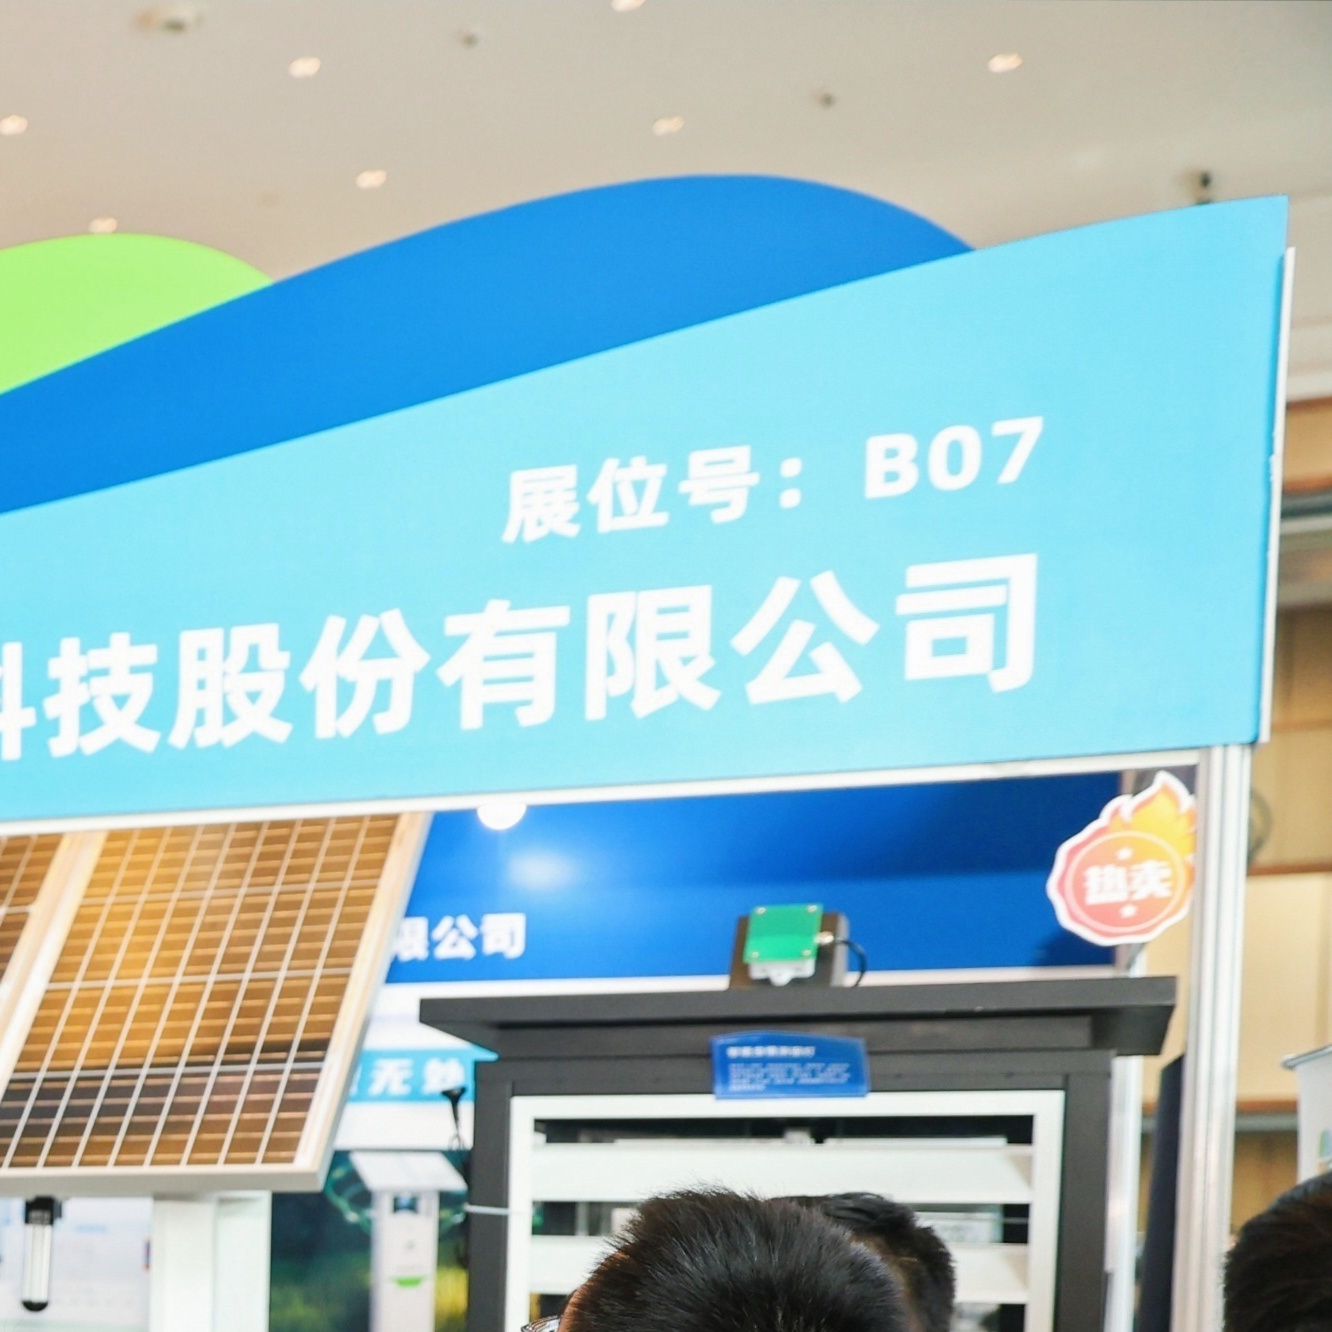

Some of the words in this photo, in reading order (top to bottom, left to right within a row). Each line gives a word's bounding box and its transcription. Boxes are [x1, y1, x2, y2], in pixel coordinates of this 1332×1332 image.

[502, 445, 803, 544] 展位号：
[864, 415, 1045, 500] B07
[1083, 859, 1173, 907] 热卖
